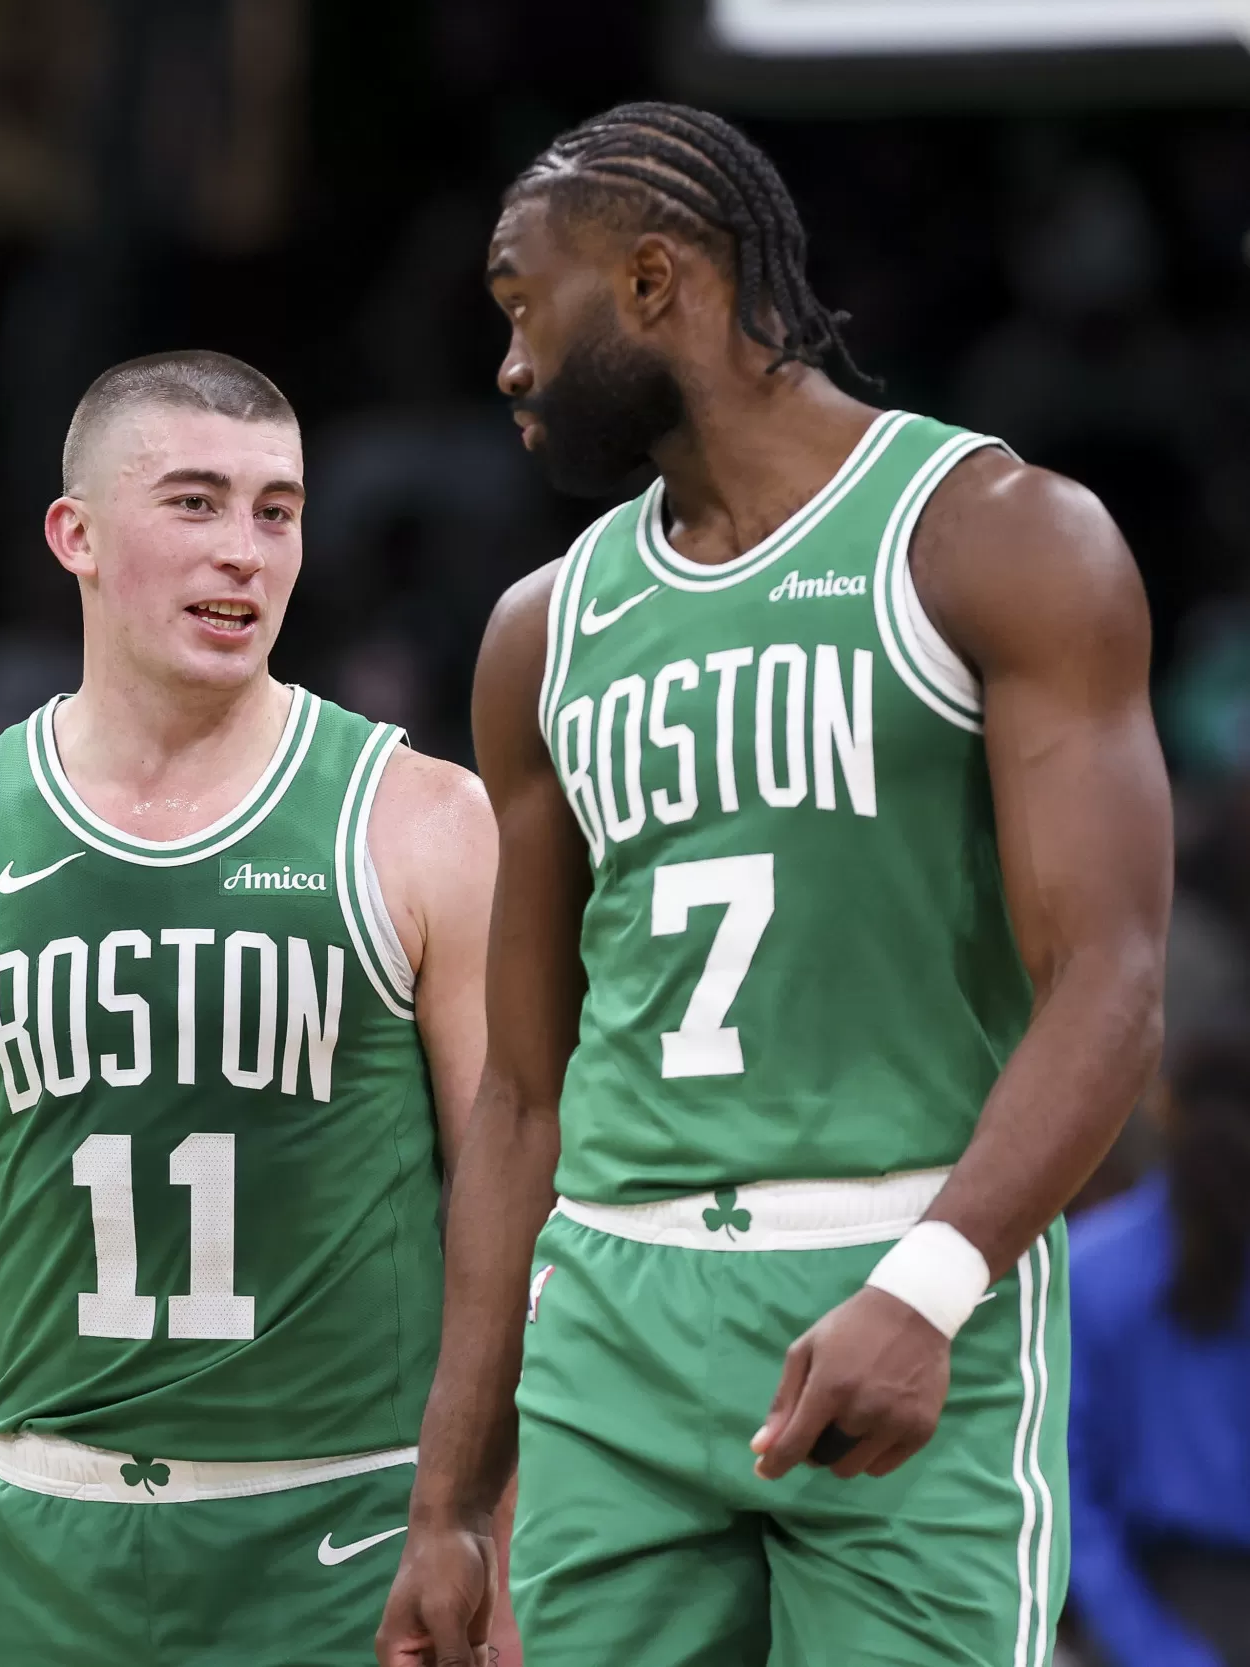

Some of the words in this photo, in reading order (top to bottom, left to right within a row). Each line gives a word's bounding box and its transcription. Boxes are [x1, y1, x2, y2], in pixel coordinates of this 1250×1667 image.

[768, 569, 867, 603] Amica
[557, 643, 878, 869] BOSTON
[223, 863, 327, 891] Amica
[651, 852, 775, 1079] 7
[72, 1132, 255, 1339] 11
